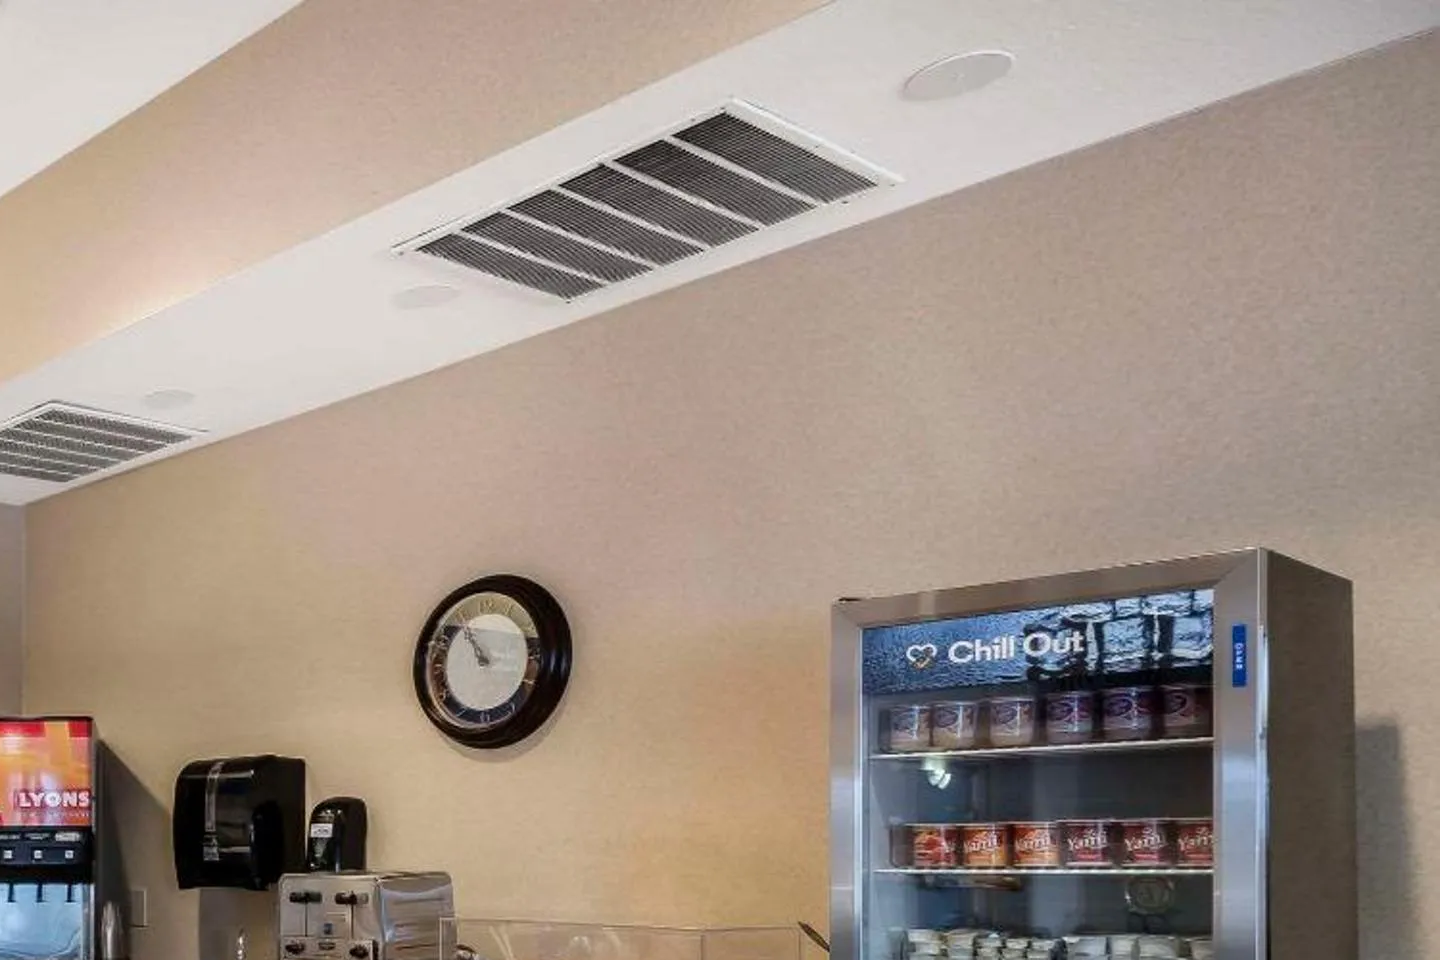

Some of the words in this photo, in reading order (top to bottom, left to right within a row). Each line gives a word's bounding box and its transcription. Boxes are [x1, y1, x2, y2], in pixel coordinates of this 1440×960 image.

[948, 634, 1015, 663] Chill
[1023, 630, 1085, 657] Out
[19, 791, 90, 808] LYONS
